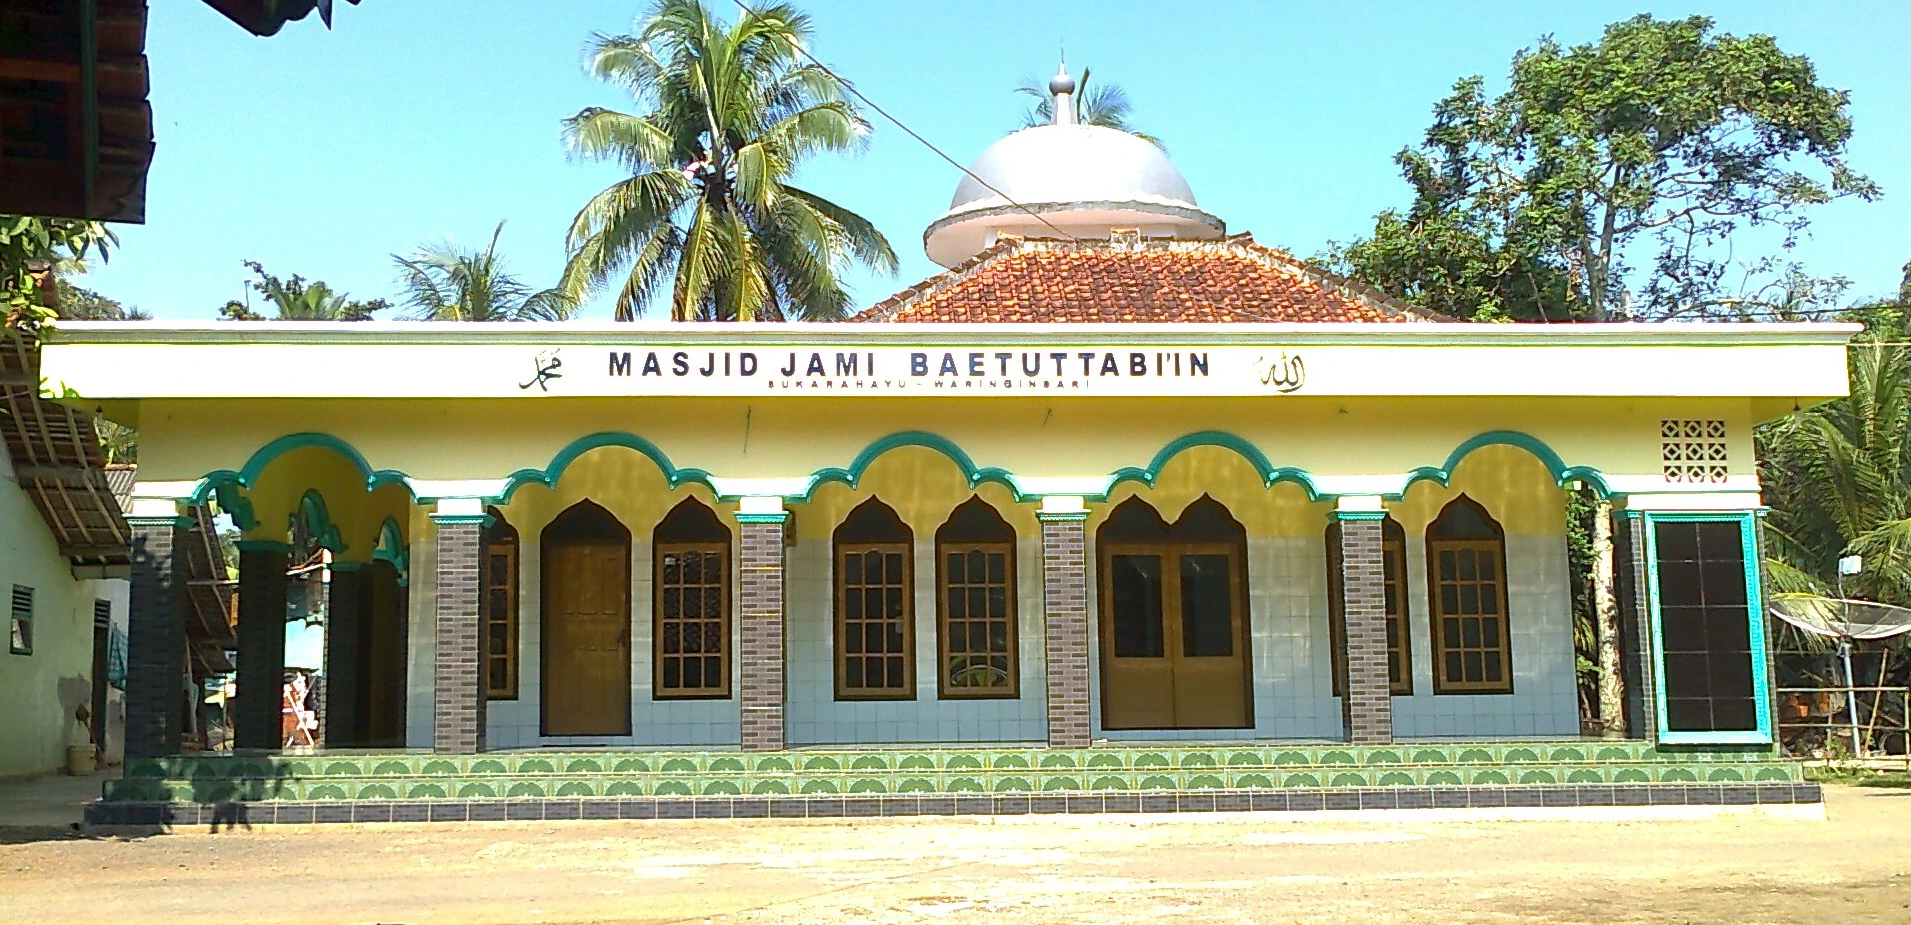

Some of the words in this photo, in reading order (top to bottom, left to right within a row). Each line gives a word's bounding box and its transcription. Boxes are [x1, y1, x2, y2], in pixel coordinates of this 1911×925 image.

[608, 351, 758, 378] MASJID
[780, 351, 875, 378] JAMI
[910, 351, 1210, 378] BAETUTTABI'IN
